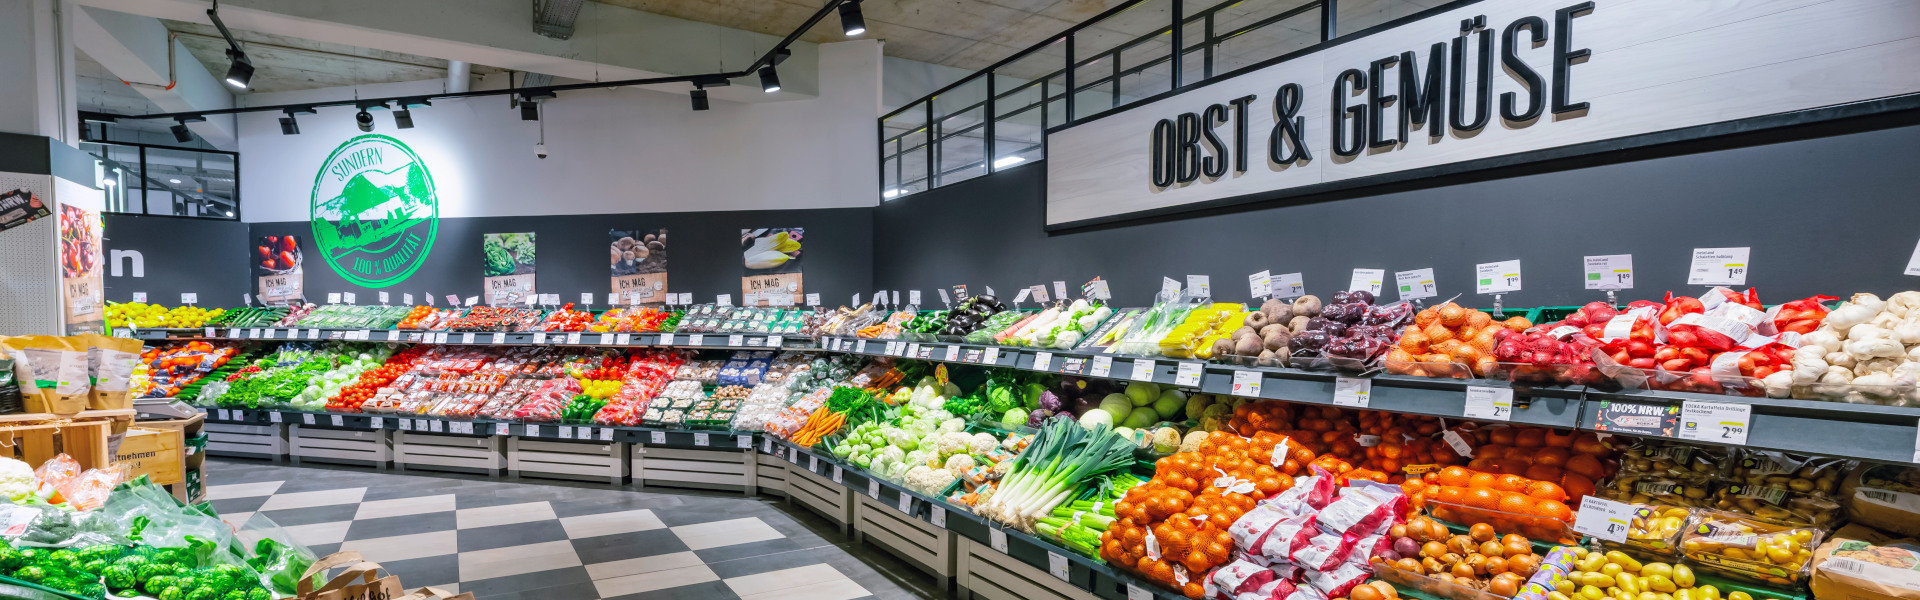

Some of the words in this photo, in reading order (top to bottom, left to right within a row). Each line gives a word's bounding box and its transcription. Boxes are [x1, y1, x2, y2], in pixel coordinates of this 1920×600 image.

[1153, 95, 1257, 187] OBST
[1270, 82, 1313, 165] &
[1332, 1, 1596, 156] GEMÜSE
[331, 147, 383, 182] SUNDERN
[103, 249, 145, 277] n
[352, 257, 372, 275] 100
[374, 260, 382, 275] %
[383, 232, 421, 273] QUALITÄT
[619, 280, 630, 289] ICH
[750, 279, 762, 290] ICH
[764, 278, 780, 288] MAG
[1611, 403, 1637, 414] 100%
[1637, 405, 1665, 417] NRW.
